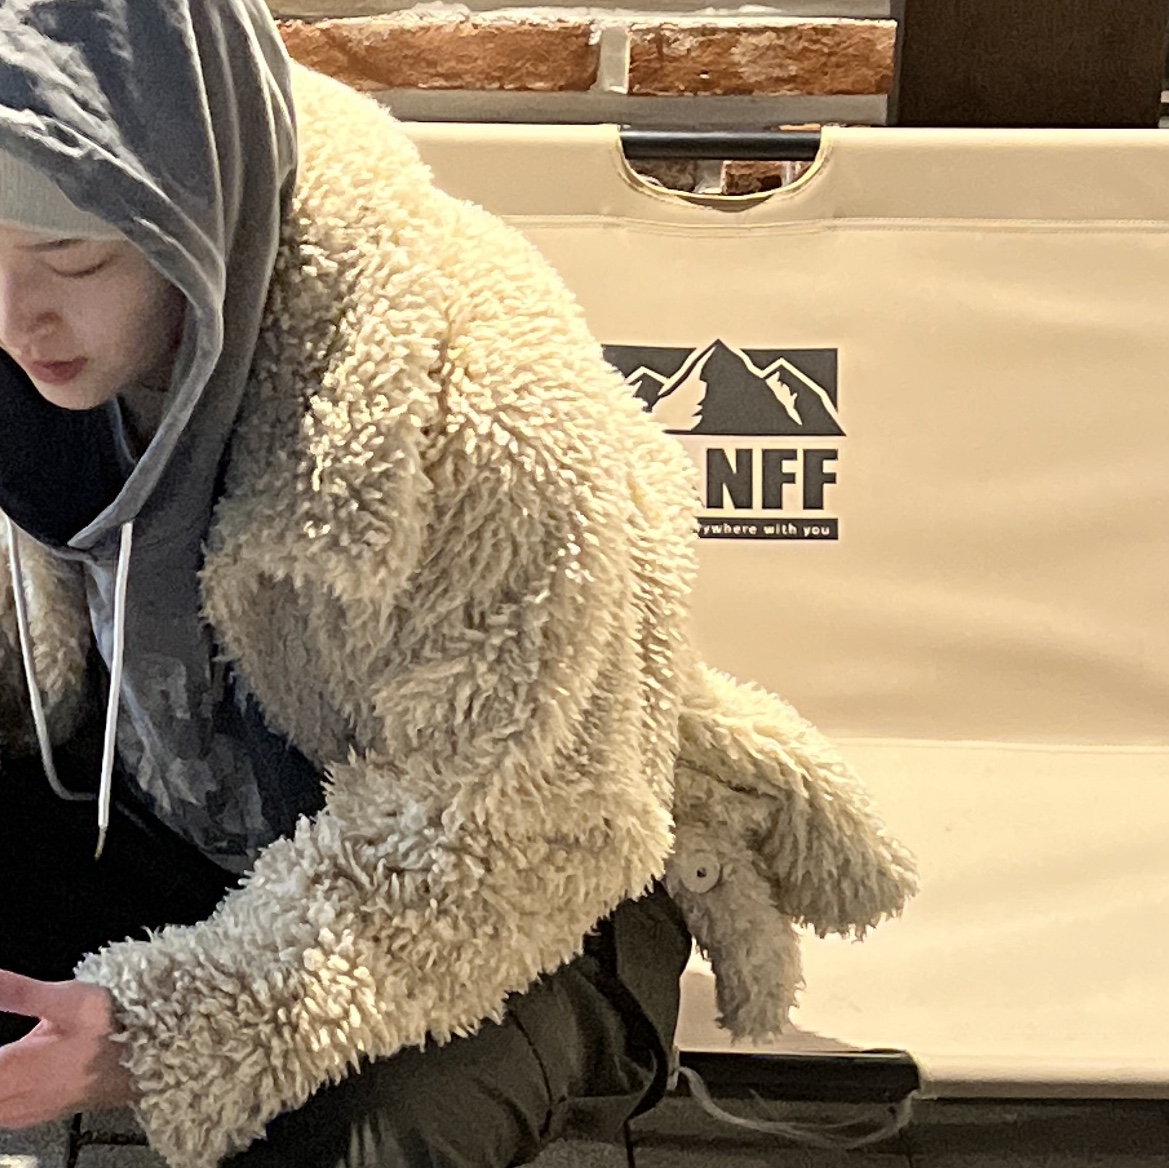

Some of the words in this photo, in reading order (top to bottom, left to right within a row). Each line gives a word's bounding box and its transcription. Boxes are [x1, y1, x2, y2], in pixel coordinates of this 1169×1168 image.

[693, 447, 839, 510] NFF
[763, 522, 798, 536] with
[802, 525, 830, 537] you
